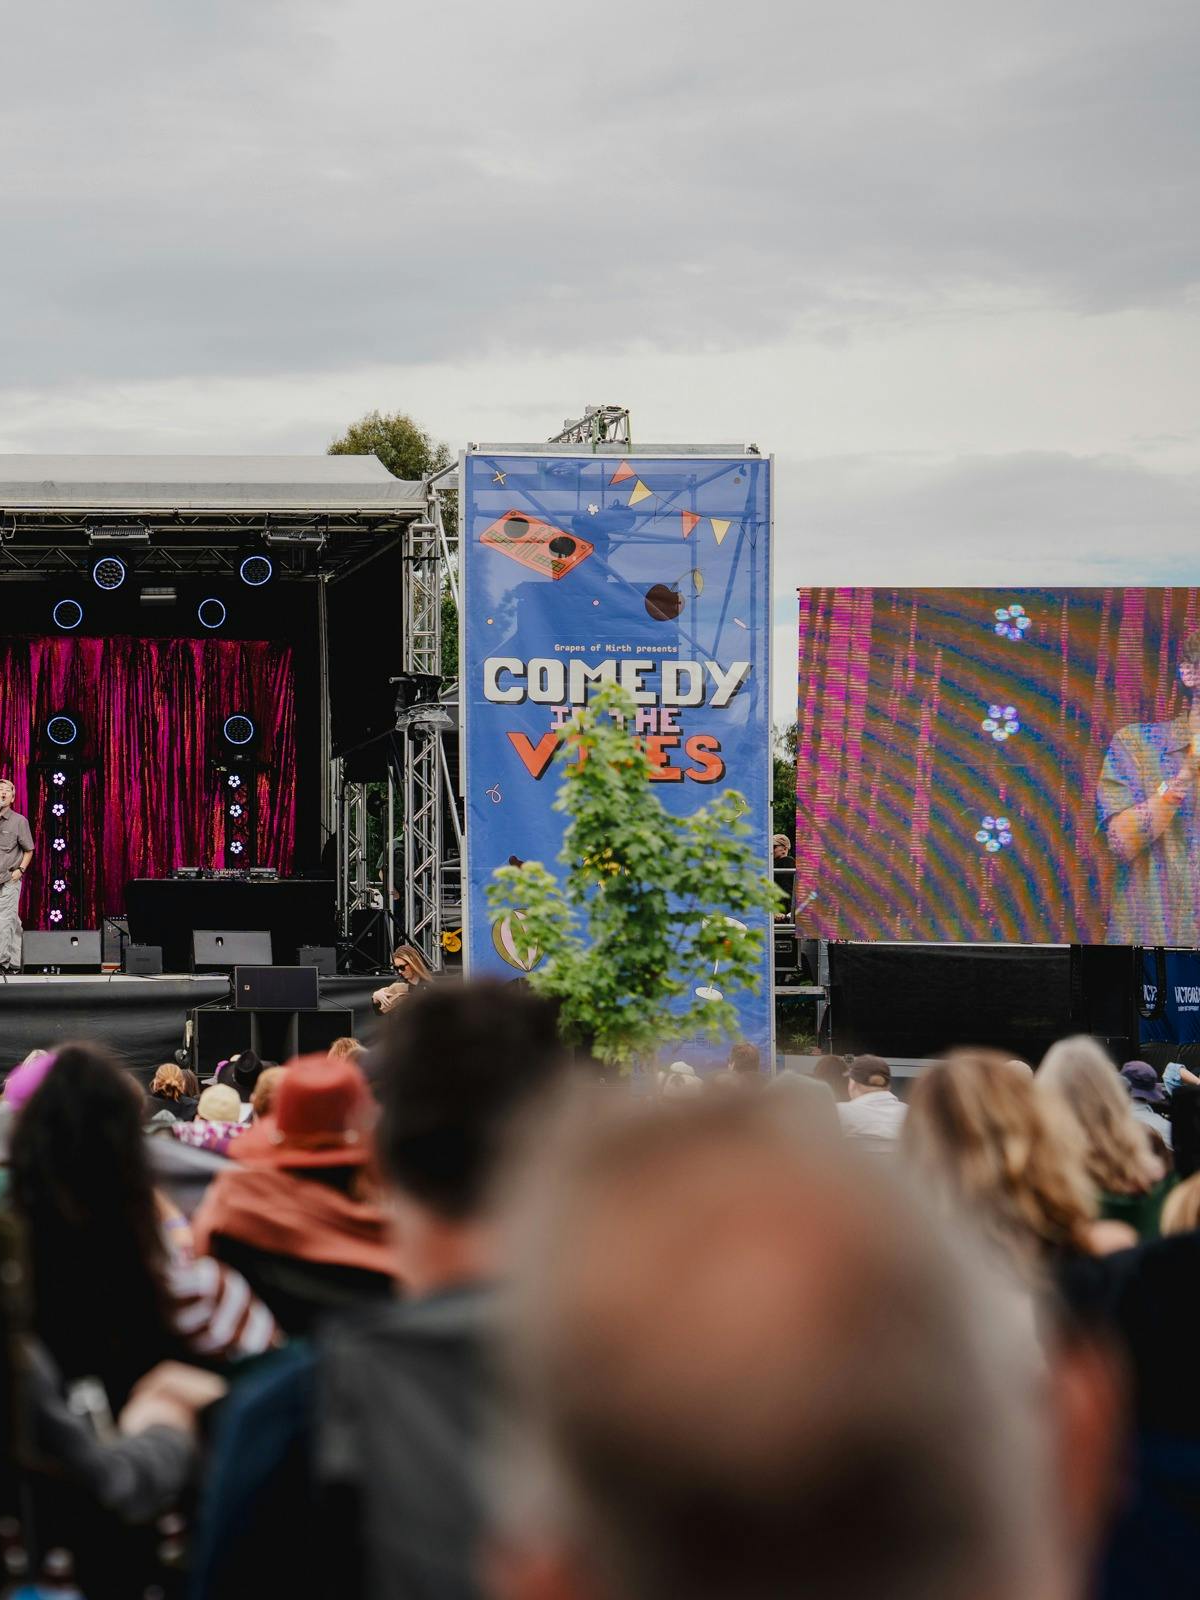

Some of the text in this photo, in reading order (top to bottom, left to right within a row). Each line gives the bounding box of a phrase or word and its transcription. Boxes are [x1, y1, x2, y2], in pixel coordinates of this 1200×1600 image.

[554, 643, 678, 655] Grapes of Mirth presents
[483, 657, 752, 707] COMEDY
